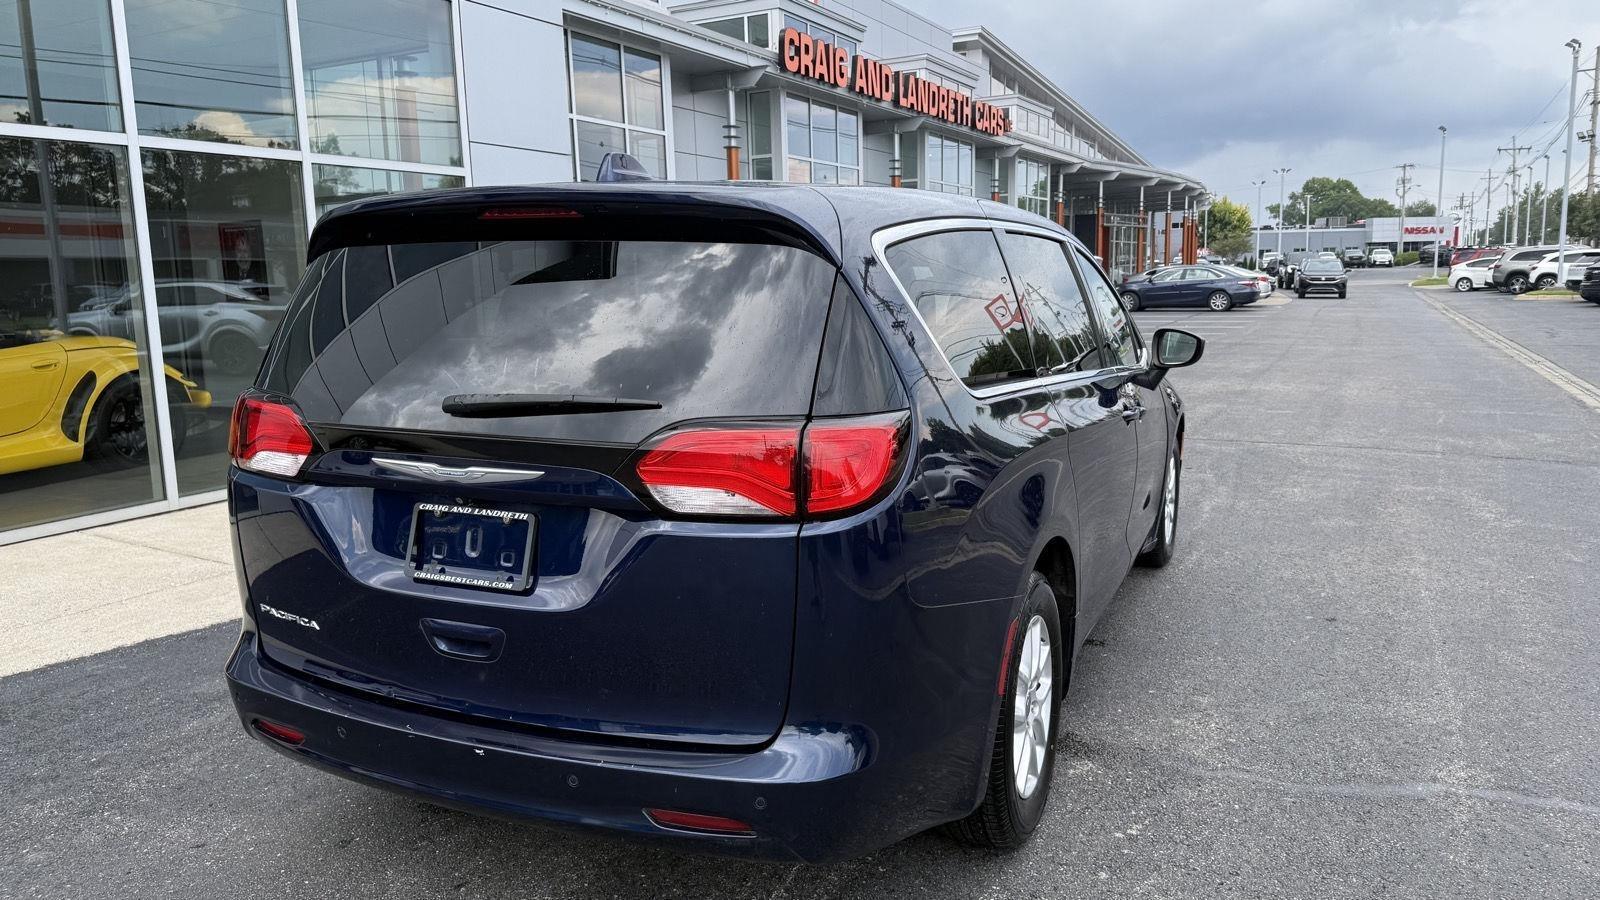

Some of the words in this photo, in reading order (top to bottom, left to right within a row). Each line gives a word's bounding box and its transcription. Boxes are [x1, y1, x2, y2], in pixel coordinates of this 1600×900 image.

[782, 27, 849, 88] CRAIG
[854, 54, 894, 102] AND
[898, 71, 972, 127] LANDRETH
[975, 100, 1004, 136] CARS
[418, 503, 449, 512] CRAIG
[450, 505, 472, 514] AND
[474, 507, 529, 521] LANDRETH
[414, 571, 513, 590] CRAIGSBESTCARS.COM
[259, 603, 320, 630] PACIFICA
